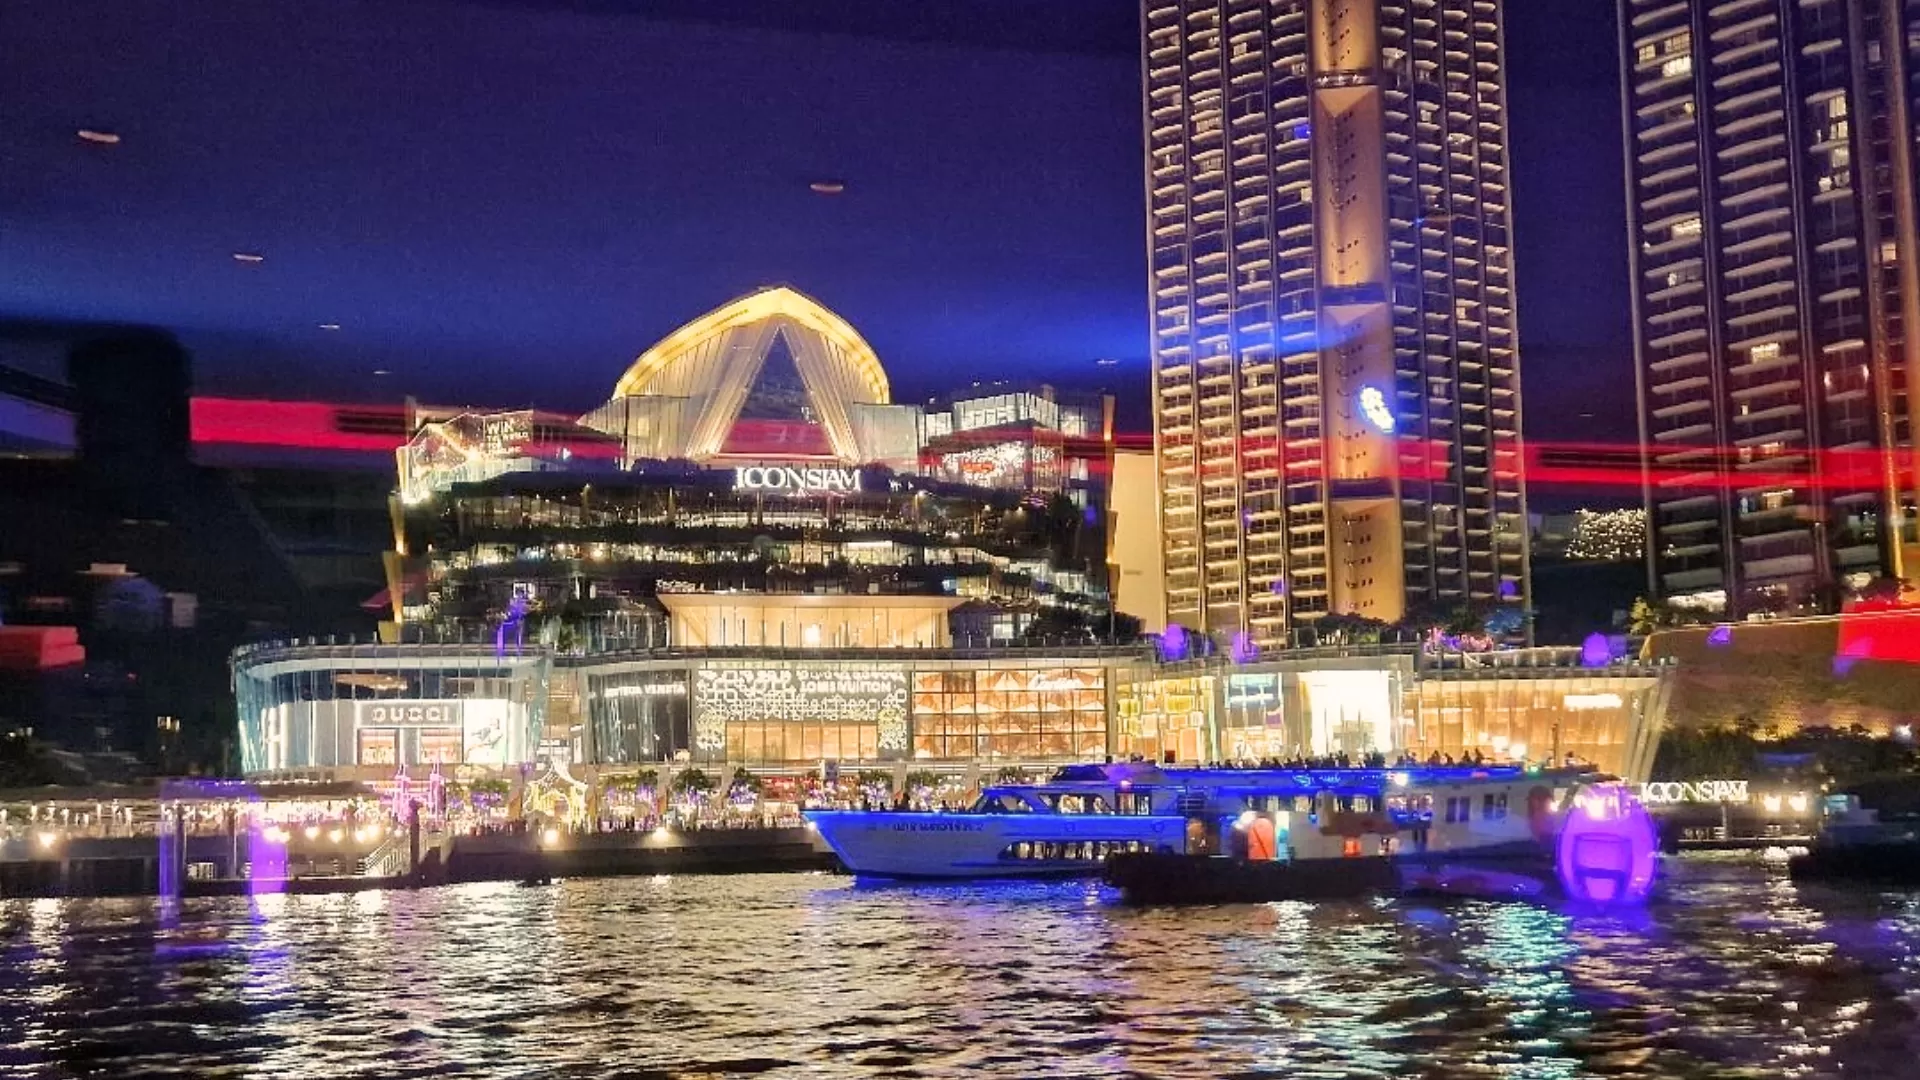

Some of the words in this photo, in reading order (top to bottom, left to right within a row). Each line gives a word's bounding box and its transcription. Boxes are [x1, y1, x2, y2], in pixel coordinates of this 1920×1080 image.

[734, 466, 862, 491] ICONSIAM
[372, 706, 450, 722] GUCCI
[1640, 781, 1749, 802] ICONSIAM
